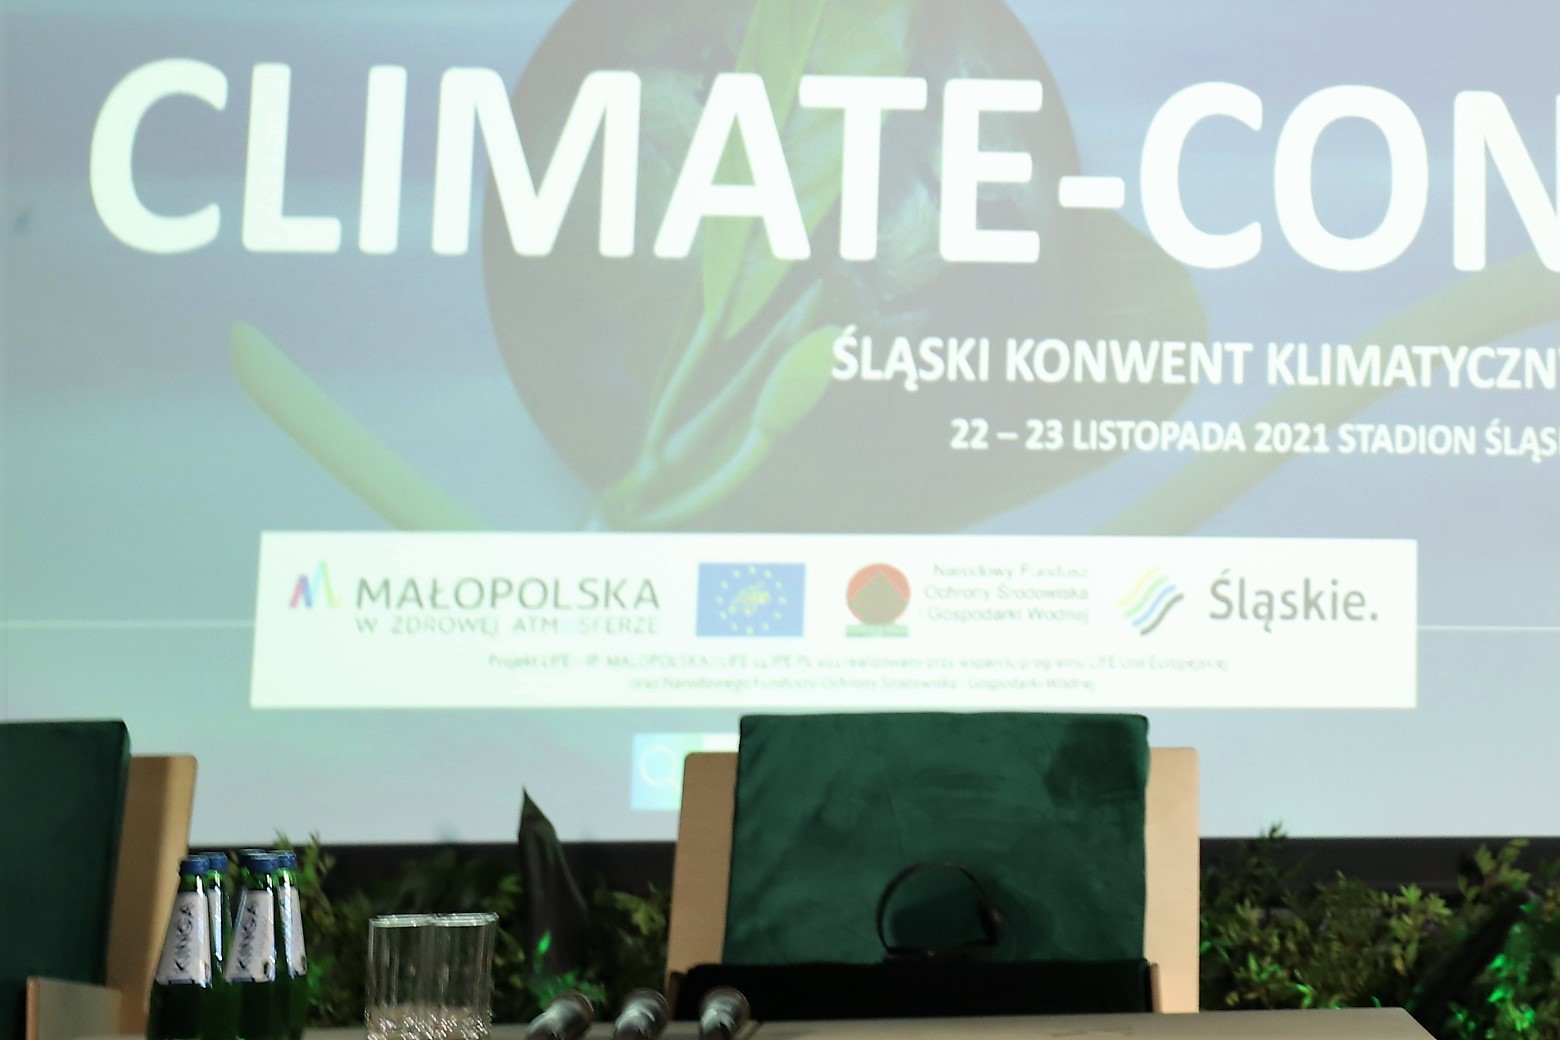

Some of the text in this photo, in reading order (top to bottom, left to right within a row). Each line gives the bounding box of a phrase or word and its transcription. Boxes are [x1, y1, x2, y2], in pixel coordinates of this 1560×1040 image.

[832, 325, 990, 392] ŚLĄSKI
[1004, 336, 1253, 388] KONWENT
[949, 416, 990, 451] 22
[1025, 418, 1064, 452] 23
[1072, 418, 1247, 454] LISTOPADA
[1253, 421, 1330, 455] 2021
[1337, 422, 1476, 456] STADION
[356, 575, 661, 611] MAŁOPOLSKA
[1208, 567, 1380, 633] Śląskie.
[355, 615, 660, 639] W ZDROWEJ ATMSFERZE
